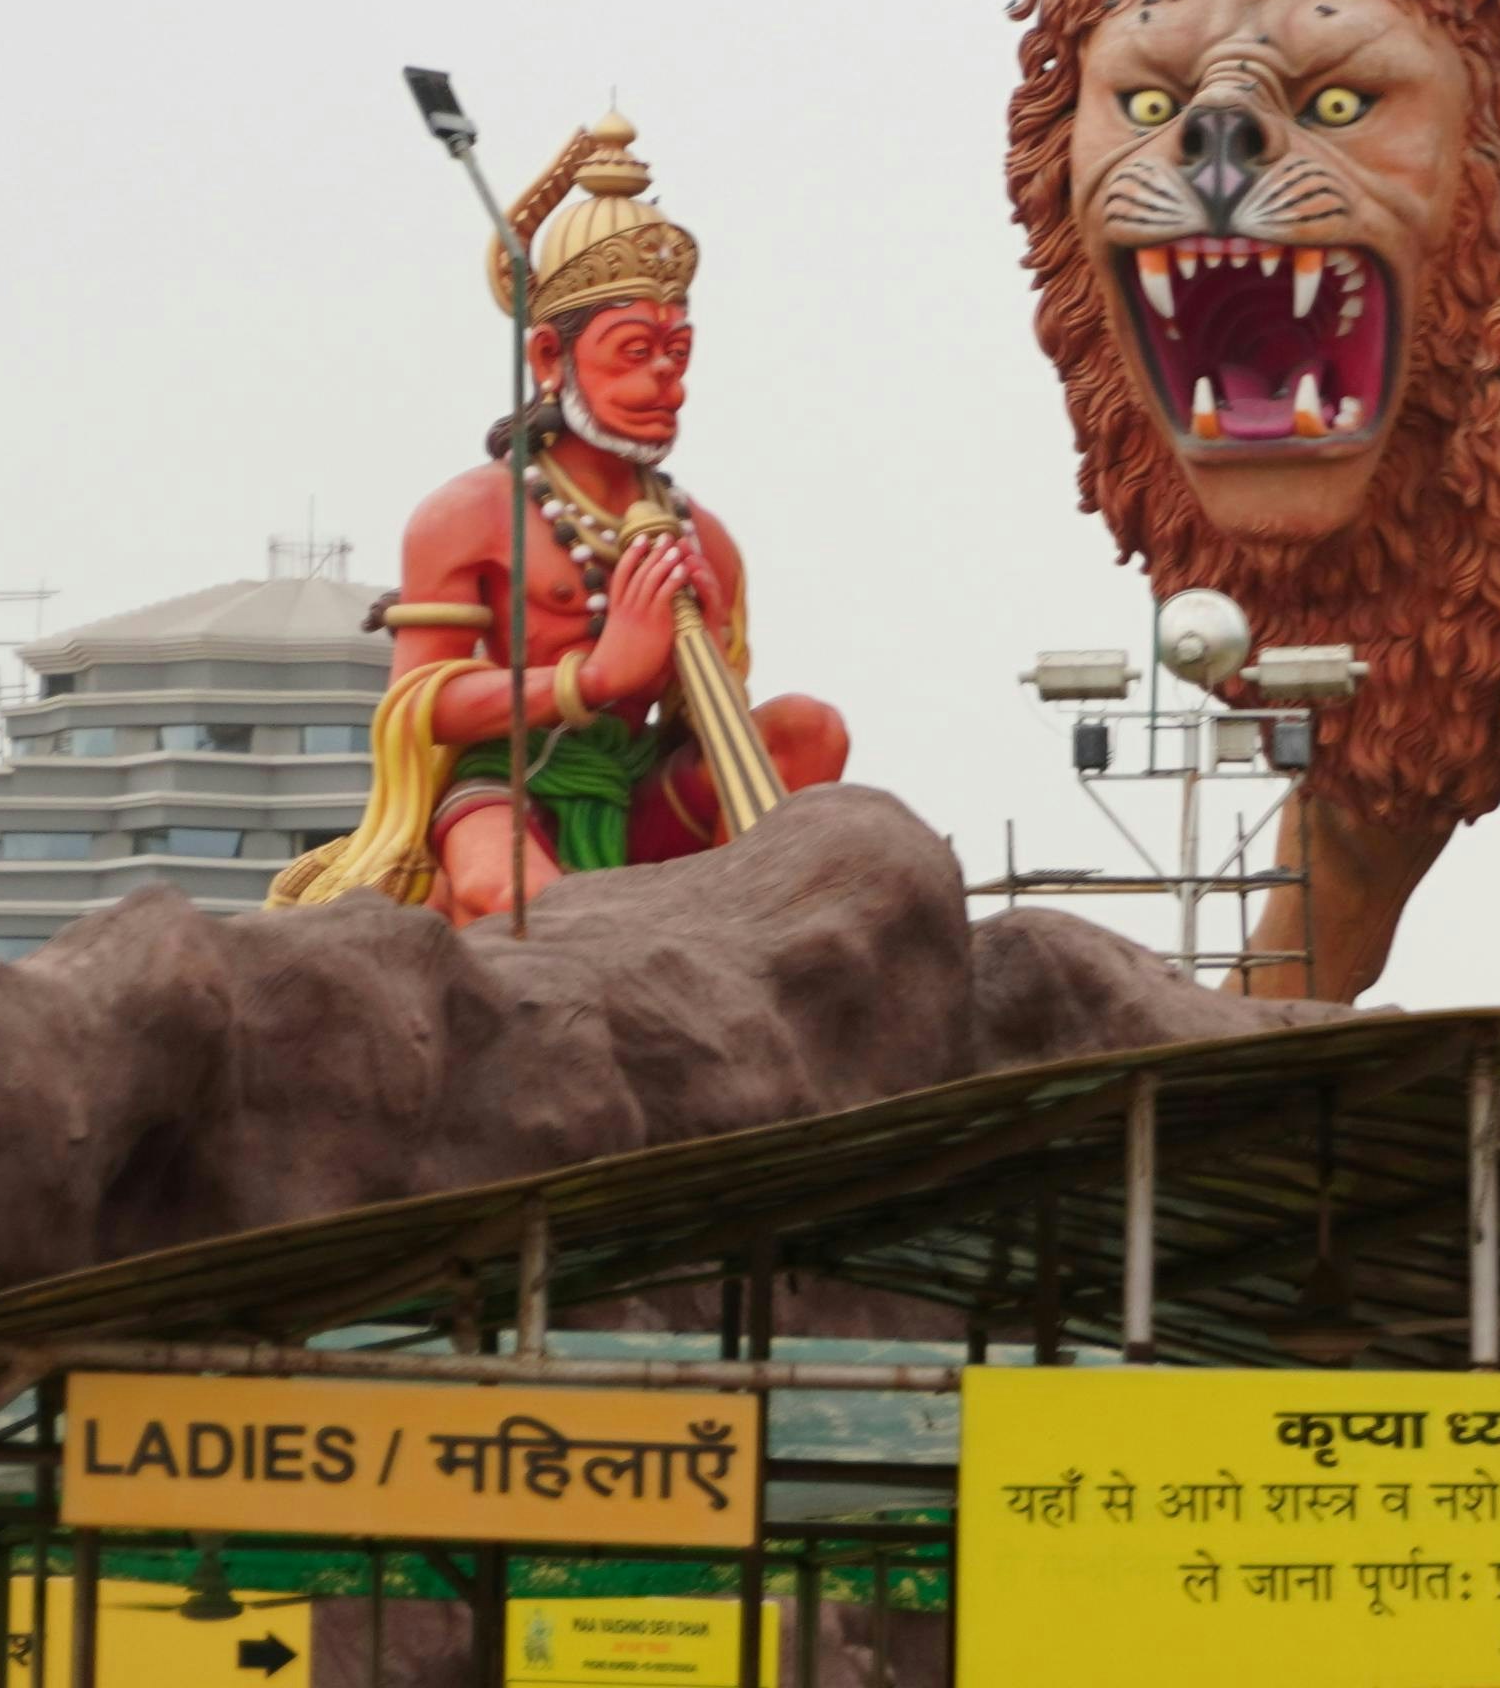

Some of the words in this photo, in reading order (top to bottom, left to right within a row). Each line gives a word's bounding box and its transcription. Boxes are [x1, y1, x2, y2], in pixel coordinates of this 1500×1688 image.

[83, 1417, 357, 1485] LADIES
[377, 1429, 403, 1486] /
[428, 1415, 738, 1512] महिलाएँ
[1274, 1410, 1429, 1468] कृप्या
[1002, 1468, 1085, 1527] यहाँ
[1097, 1470, 1137, 1523] से
[1158, 1469, 1244, 1523] आगे
[1261, 1482, 1360, 1522] शस्त्र
[1376, 1482, 1412, 1520] व
[1428, 1468, 1500, 1521] नशे
[1179, 1550, 1222, 1602] ले
[1238, 1563, 1335, 1602] जाना
